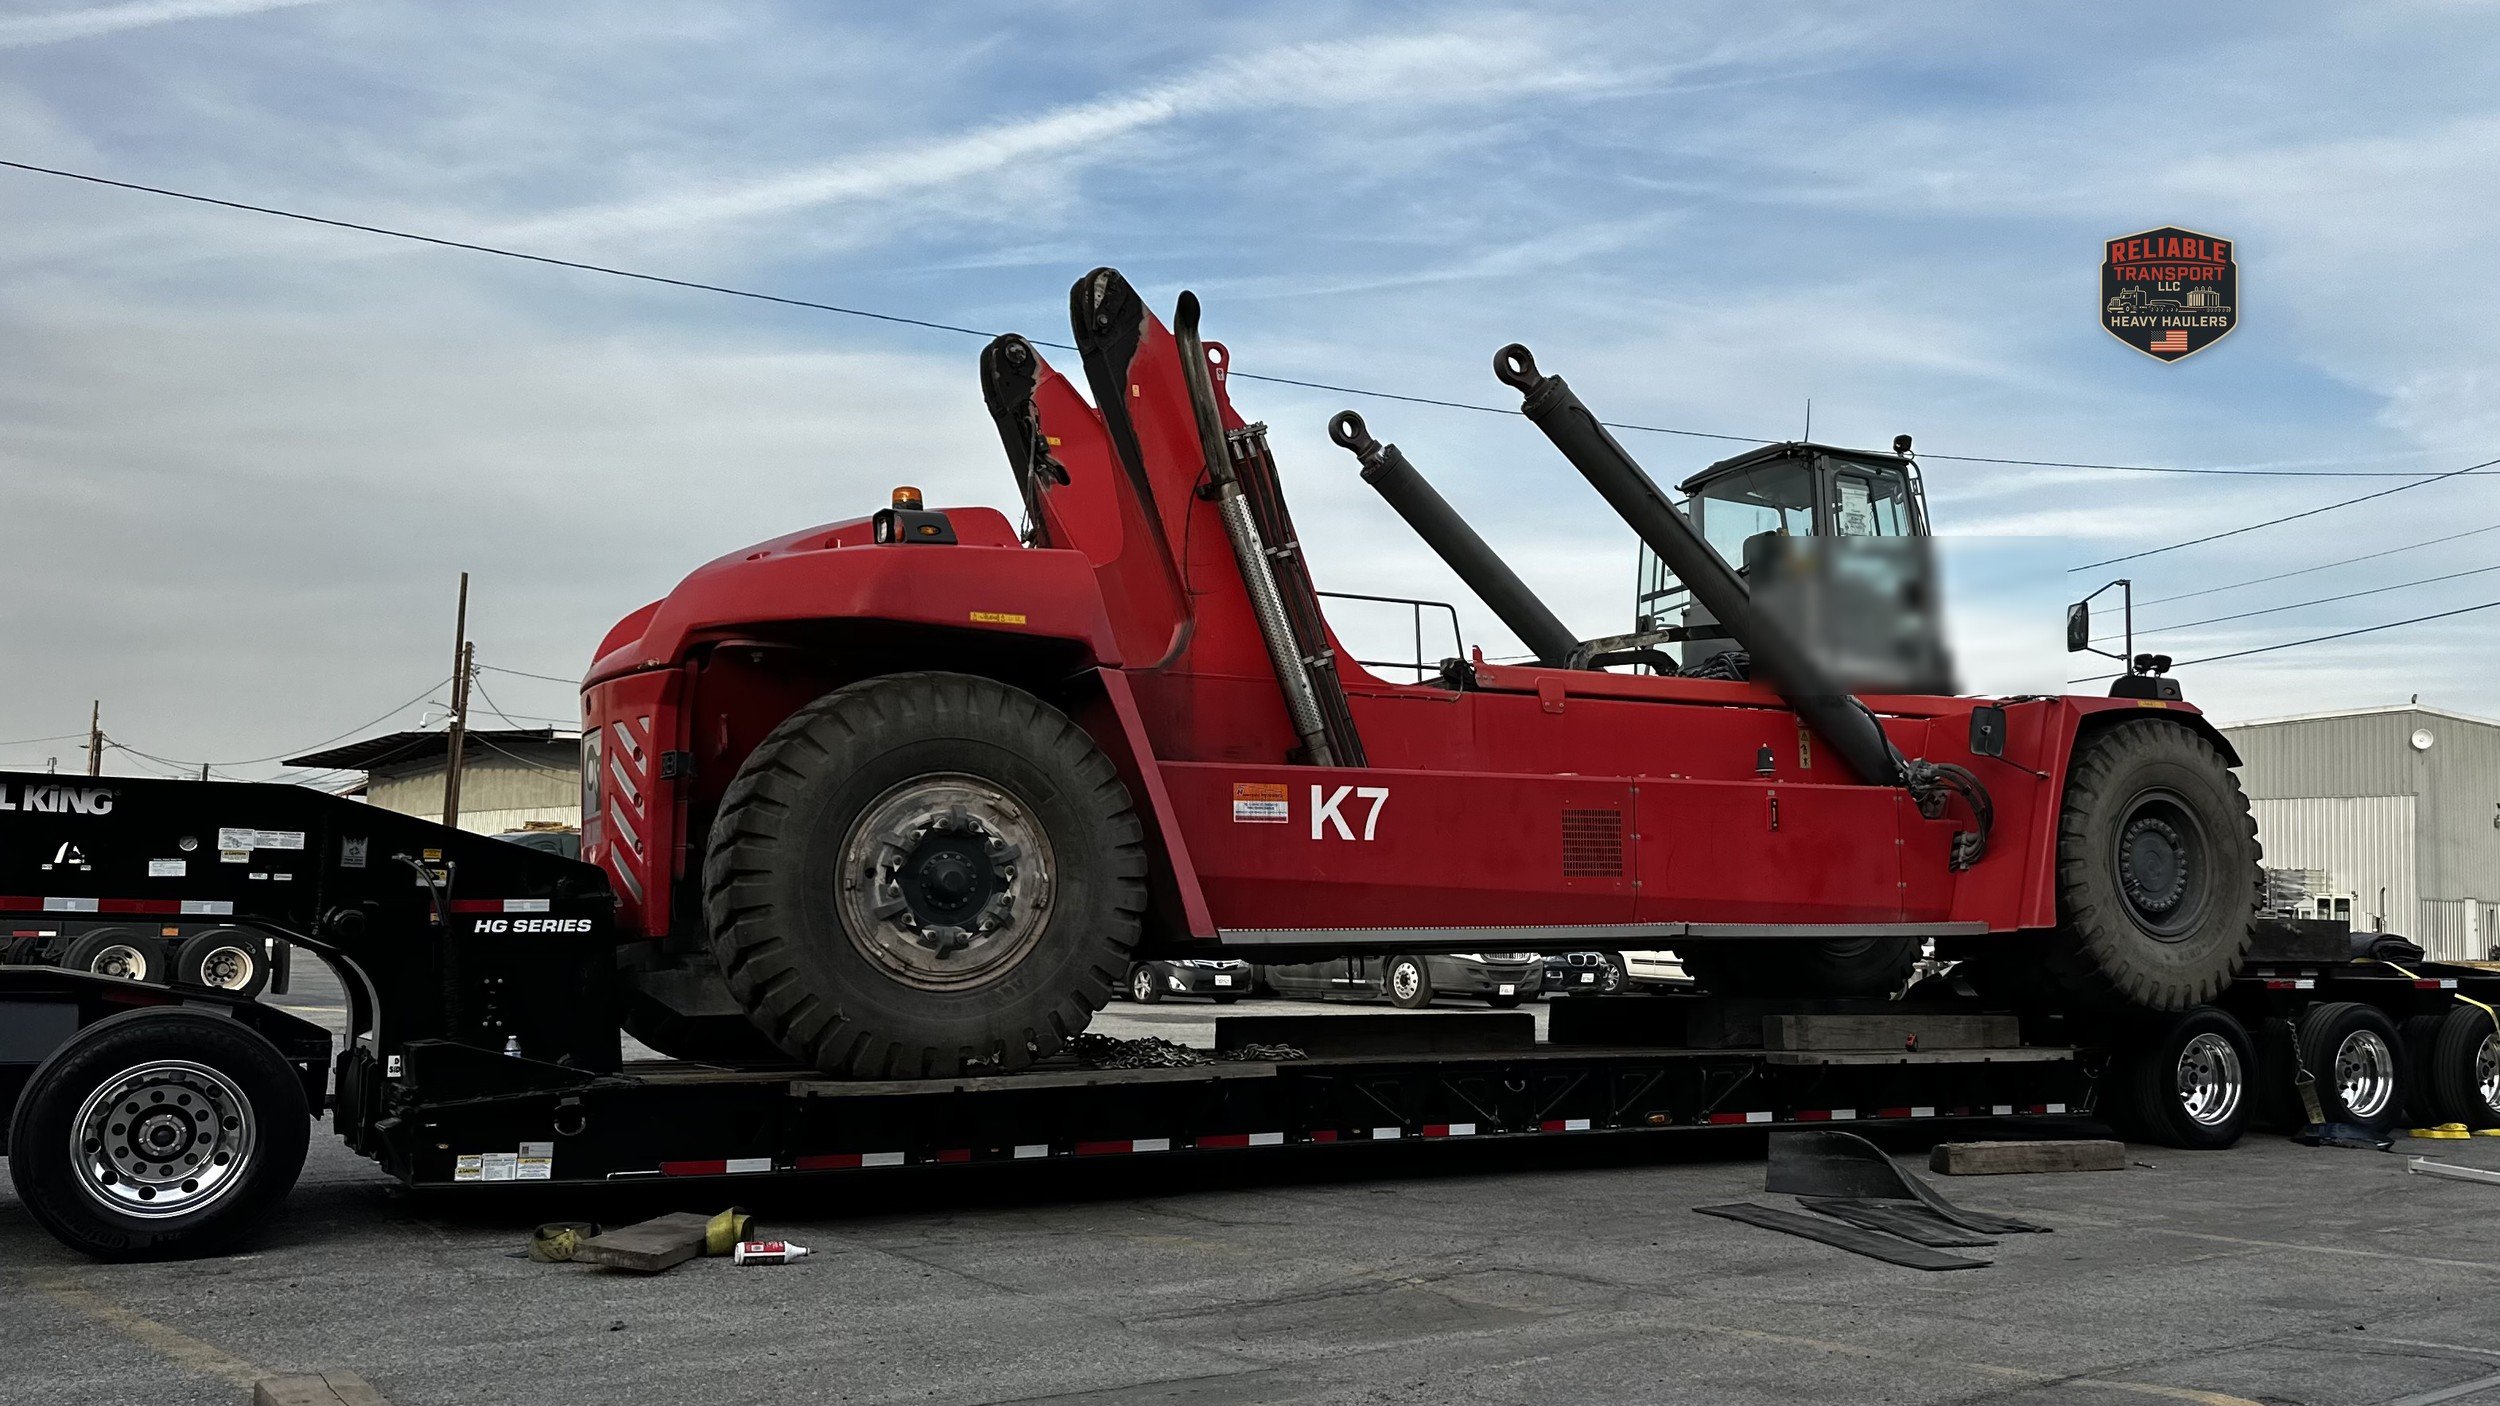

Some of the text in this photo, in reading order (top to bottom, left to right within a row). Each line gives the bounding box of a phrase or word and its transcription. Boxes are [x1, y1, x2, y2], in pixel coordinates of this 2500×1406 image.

[1310, 784, 1390, 841] K7
[474, 919, 592, 933] HG SERIES
